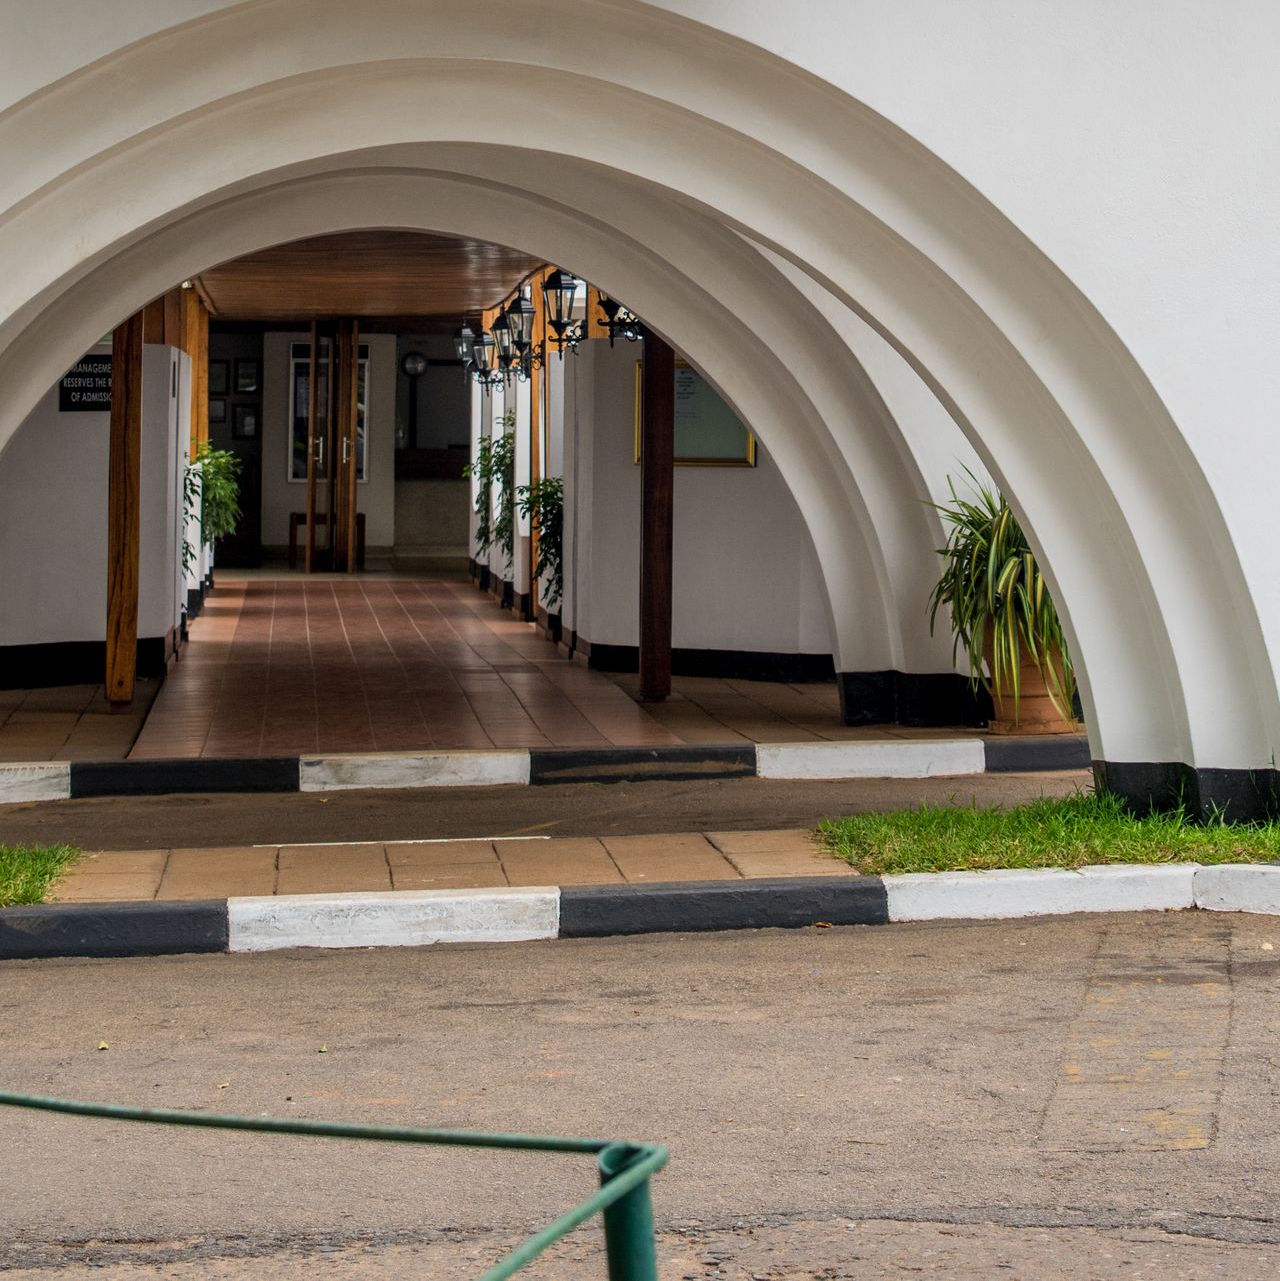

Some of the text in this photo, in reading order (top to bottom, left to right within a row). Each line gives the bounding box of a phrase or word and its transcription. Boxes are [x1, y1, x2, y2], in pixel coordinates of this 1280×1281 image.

[63, 378, 94, 387] RESERVES
[95, 378, 107, 387] THE
[71, 392, 80, 402] OF
